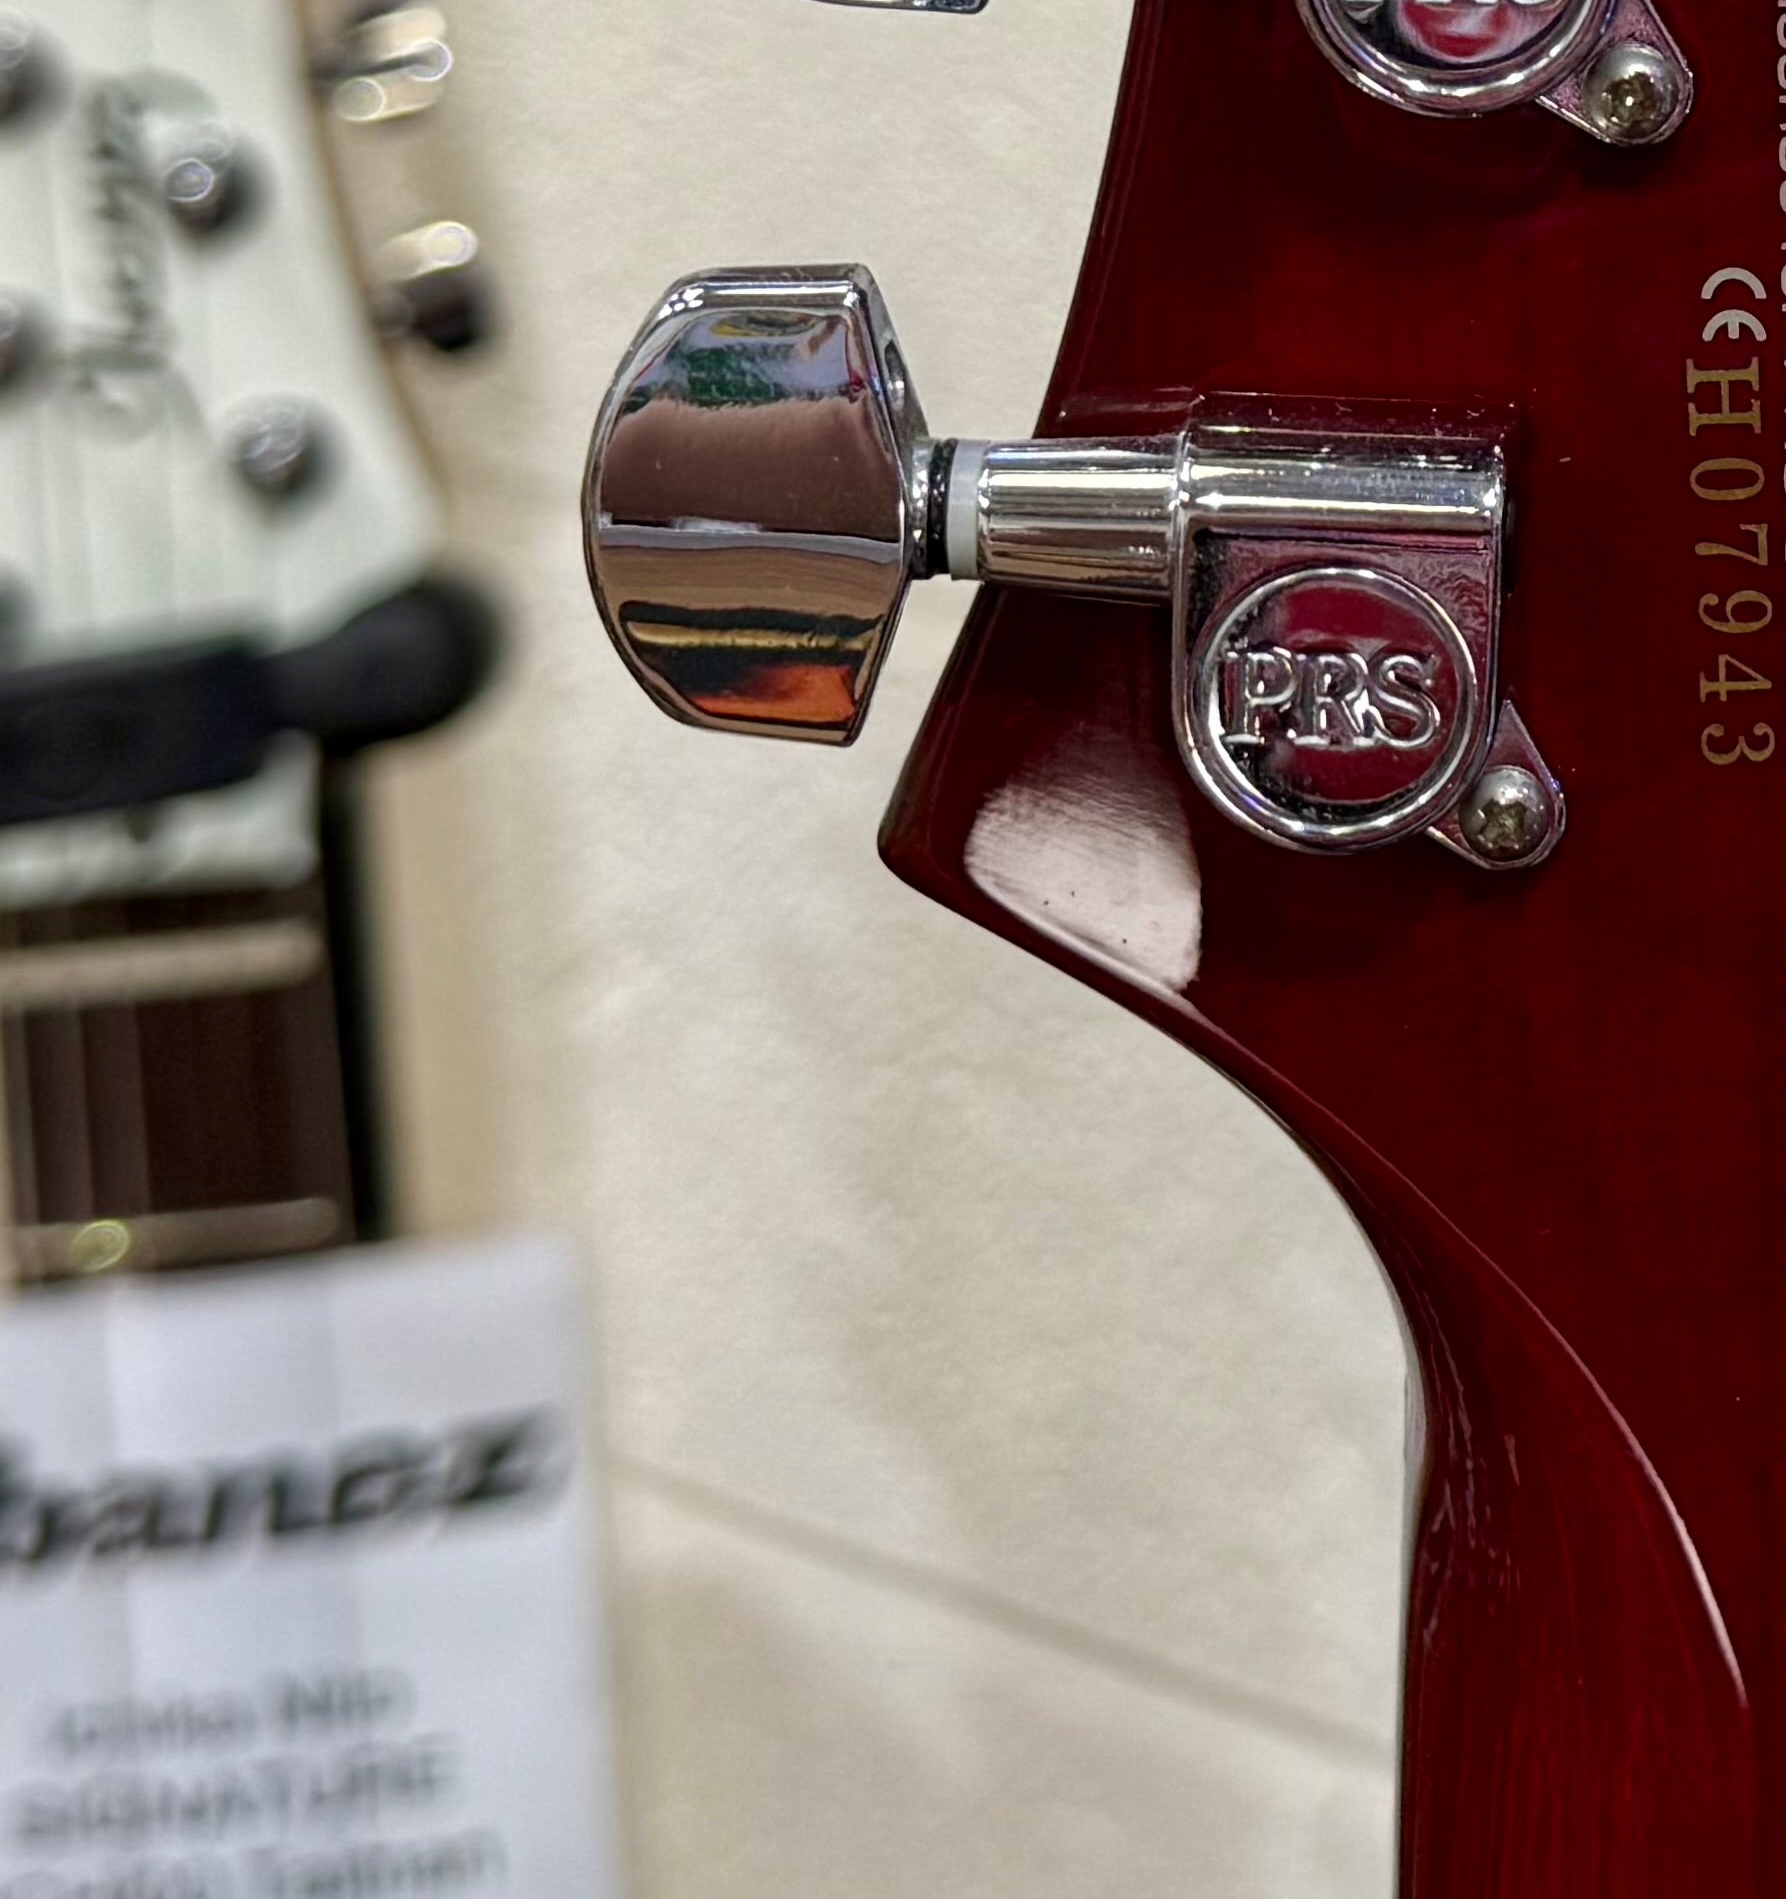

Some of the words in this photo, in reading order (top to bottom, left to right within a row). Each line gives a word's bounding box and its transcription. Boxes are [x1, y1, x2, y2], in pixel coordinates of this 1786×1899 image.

[1687, 358, 1774, 767] H07943
[1220, 645, 1445, 750] PRS
[0, 1408, 566, 1570] banez
